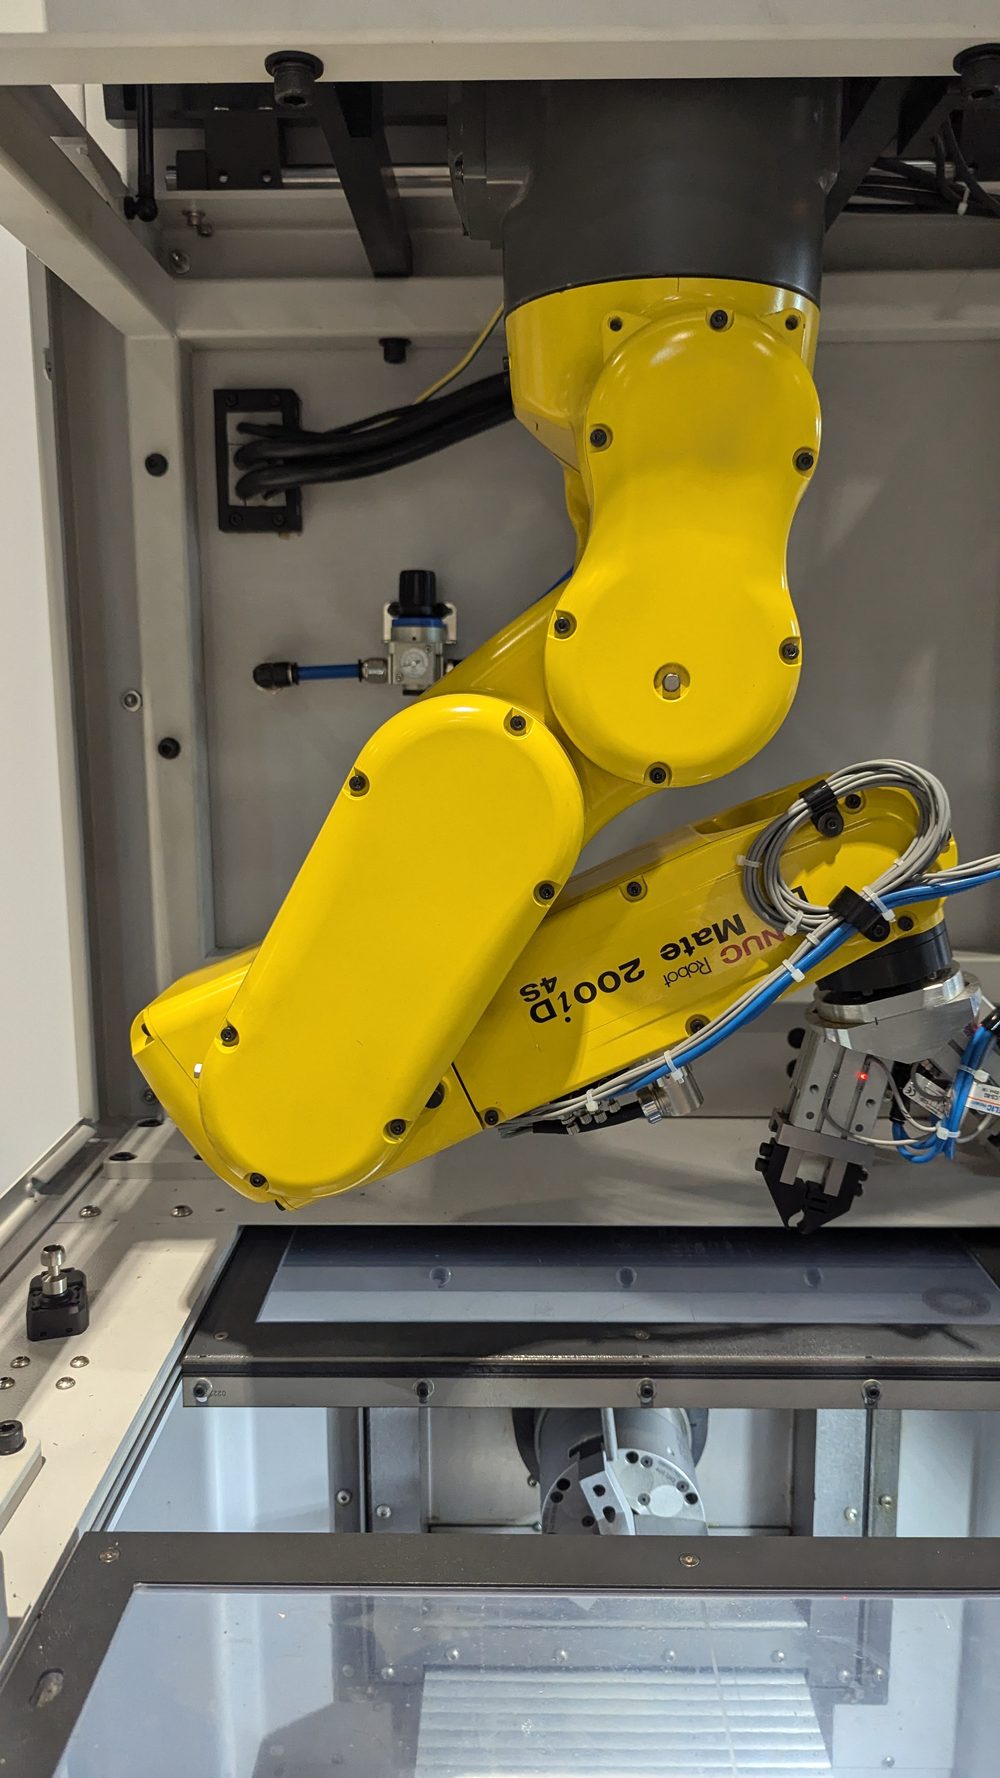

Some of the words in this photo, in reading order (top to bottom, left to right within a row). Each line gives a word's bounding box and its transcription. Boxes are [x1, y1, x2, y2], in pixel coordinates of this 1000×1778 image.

[660, 913, 746, 961] Mate
[720, 929, 786, 964] NUC
[519, 976, 558, 1002] 4S
[530, 957, 645, 1023] 200iD
[663, 957, 712, 988] Robot
